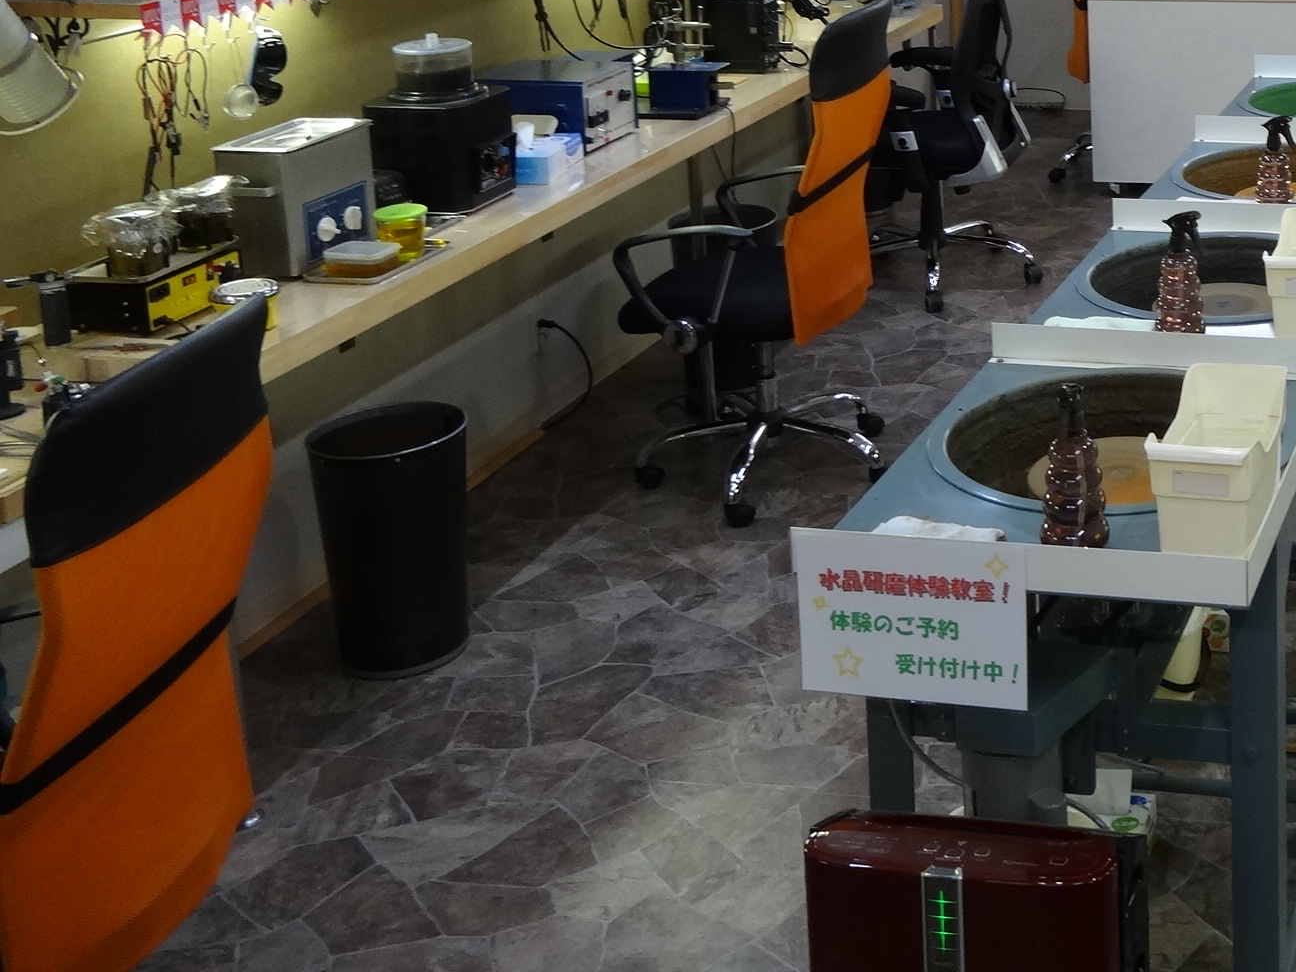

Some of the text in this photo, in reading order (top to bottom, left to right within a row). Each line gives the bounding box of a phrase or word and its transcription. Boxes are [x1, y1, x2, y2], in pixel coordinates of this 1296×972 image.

[829, 609, 960, 641] 体験のご予約
